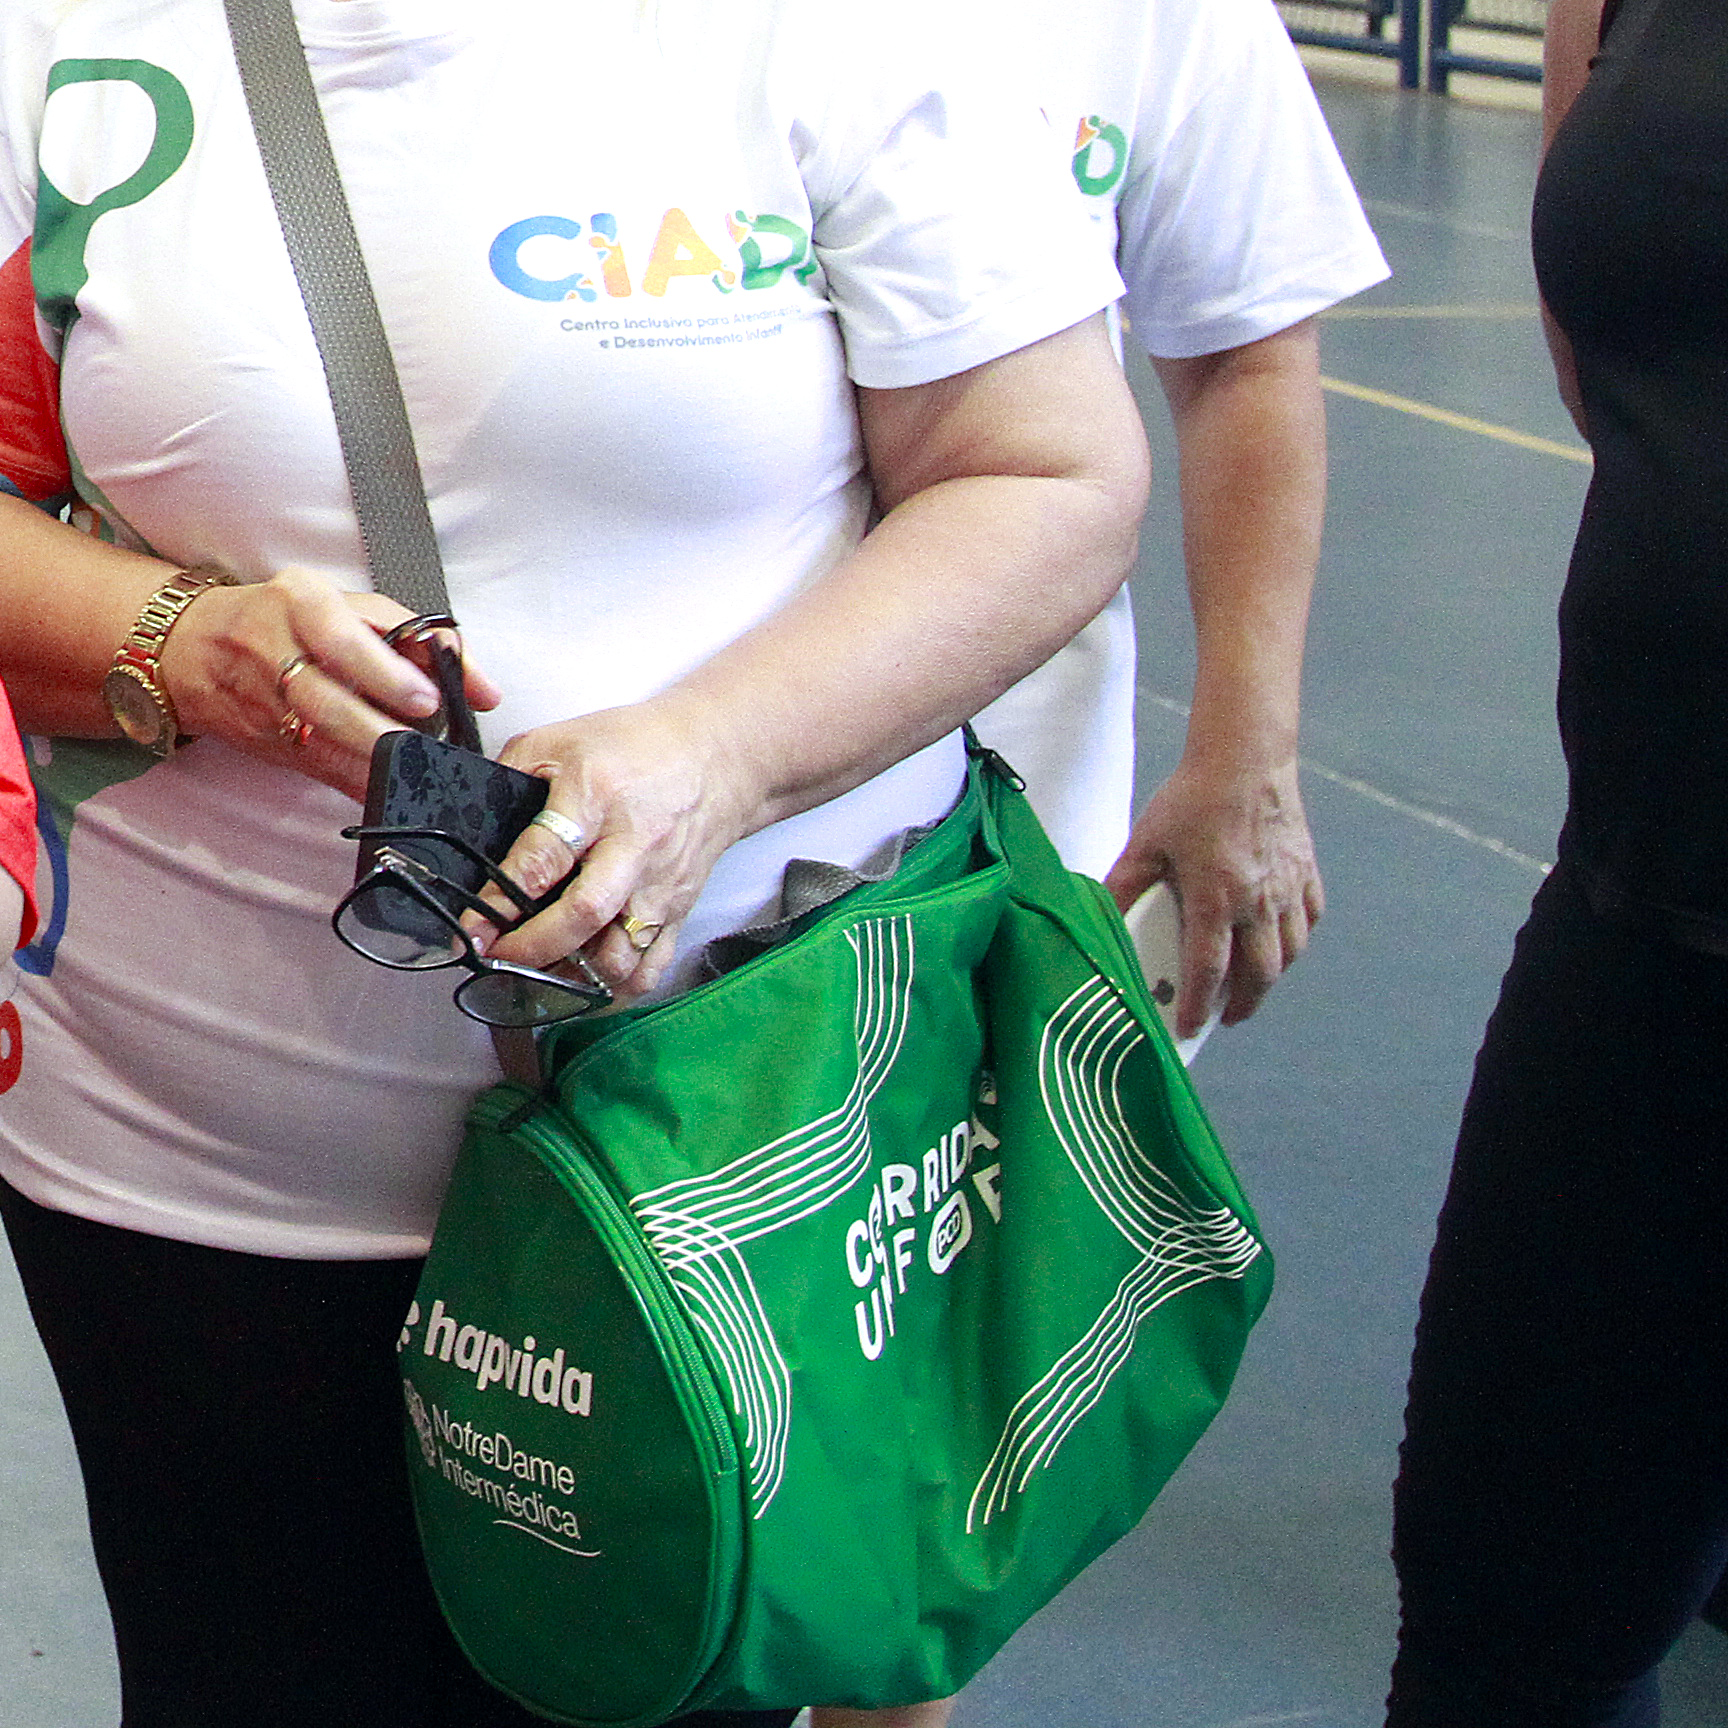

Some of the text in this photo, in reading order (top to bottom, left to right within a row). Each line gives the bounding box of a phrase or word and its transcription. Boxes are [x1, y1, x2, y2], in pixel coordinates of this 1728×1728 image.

[560, 318, 620, 332] Centro
[624, 316, 693, 330] Inclusivo
[697, 316, 730, 330] para
[423, 1299, 594, 1418] hapvida
[431, 1402, 577, 1496] NotreDame
[437, 1445, 582, 1540] Intermédica
